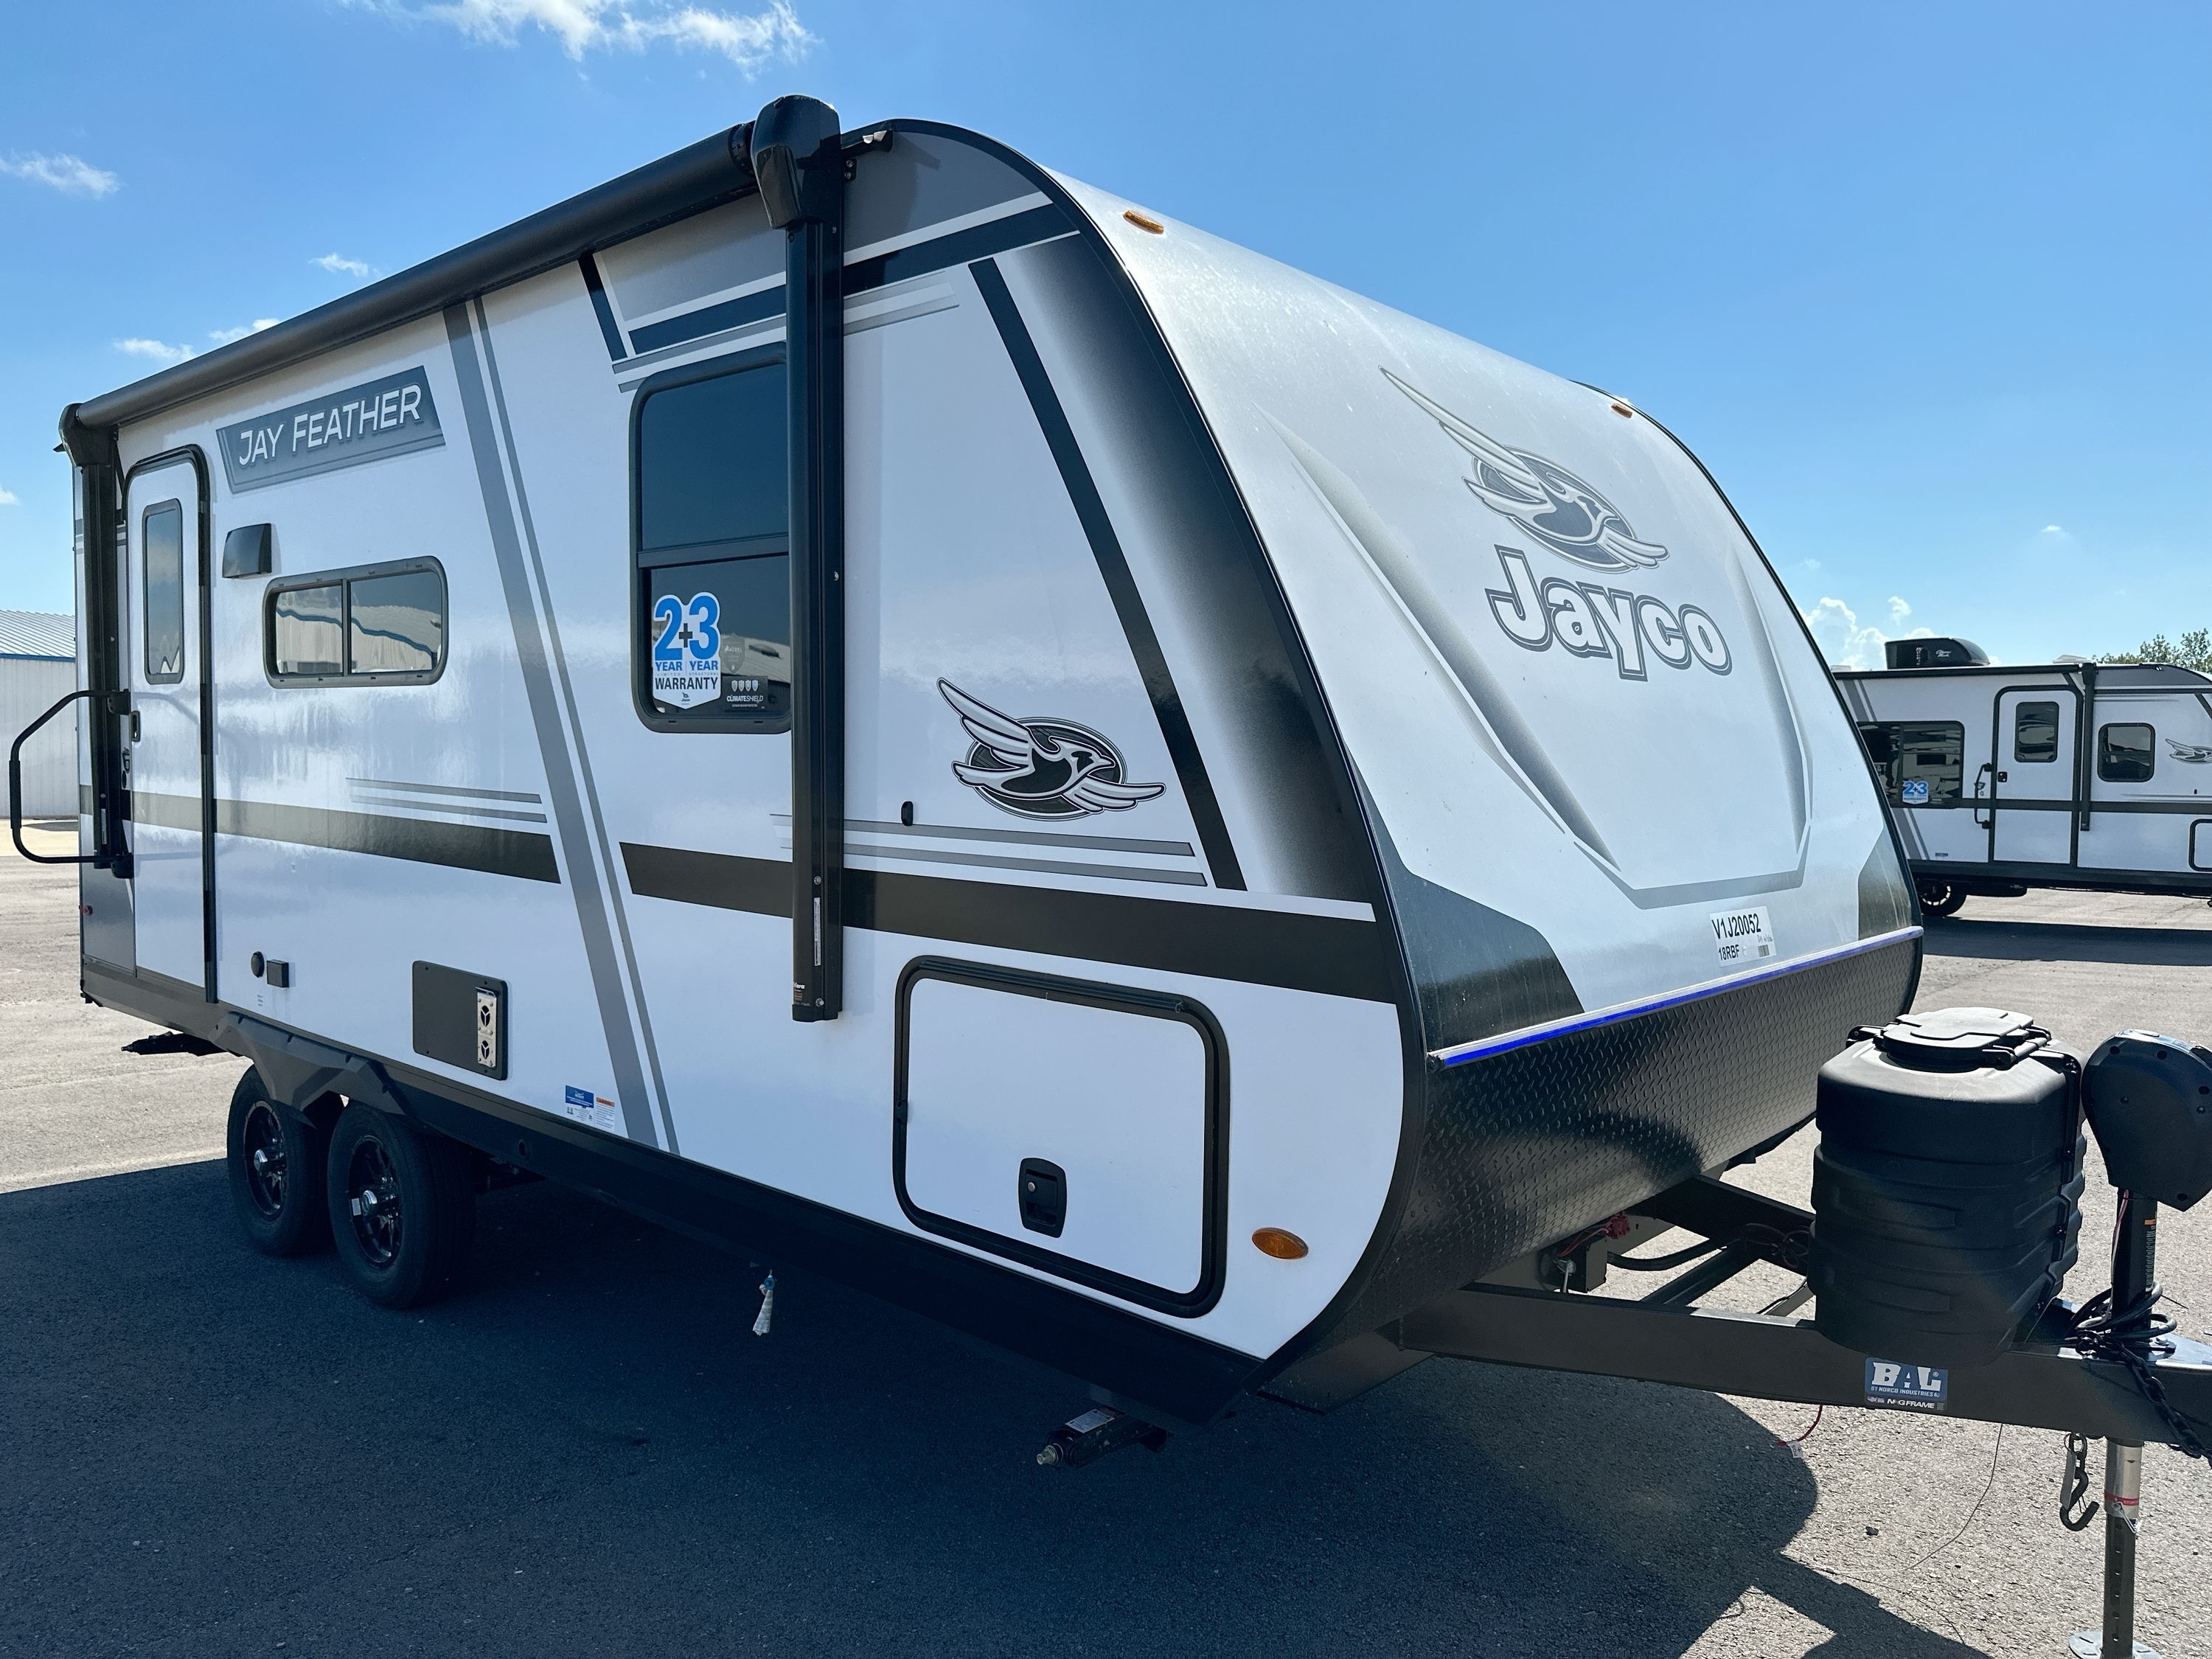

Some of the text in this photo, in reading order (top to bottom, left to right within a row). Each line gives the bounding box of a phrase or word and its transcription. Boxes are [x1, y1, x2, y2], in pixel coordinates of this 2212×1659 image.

[239, 383, 422, 466] JAY FEATHER
[1484, 544, 1733, 682] Jayco
[655, 660, 718, 672] YEAR YEAR
[655, 677, 718, 690] WARRANTY
[726, 695, 764, 703] CLIMATESHIELD
[1711, 913, 1761, 939] V1J20052
[1719, 944, 1740, 961] 18RBF
[1871, 1362, 1941, 1391] BAL
[1899, 1388, 1934, 1397] INDUSTRIES
[1905, 1400, 1935, 1409] FRAME
